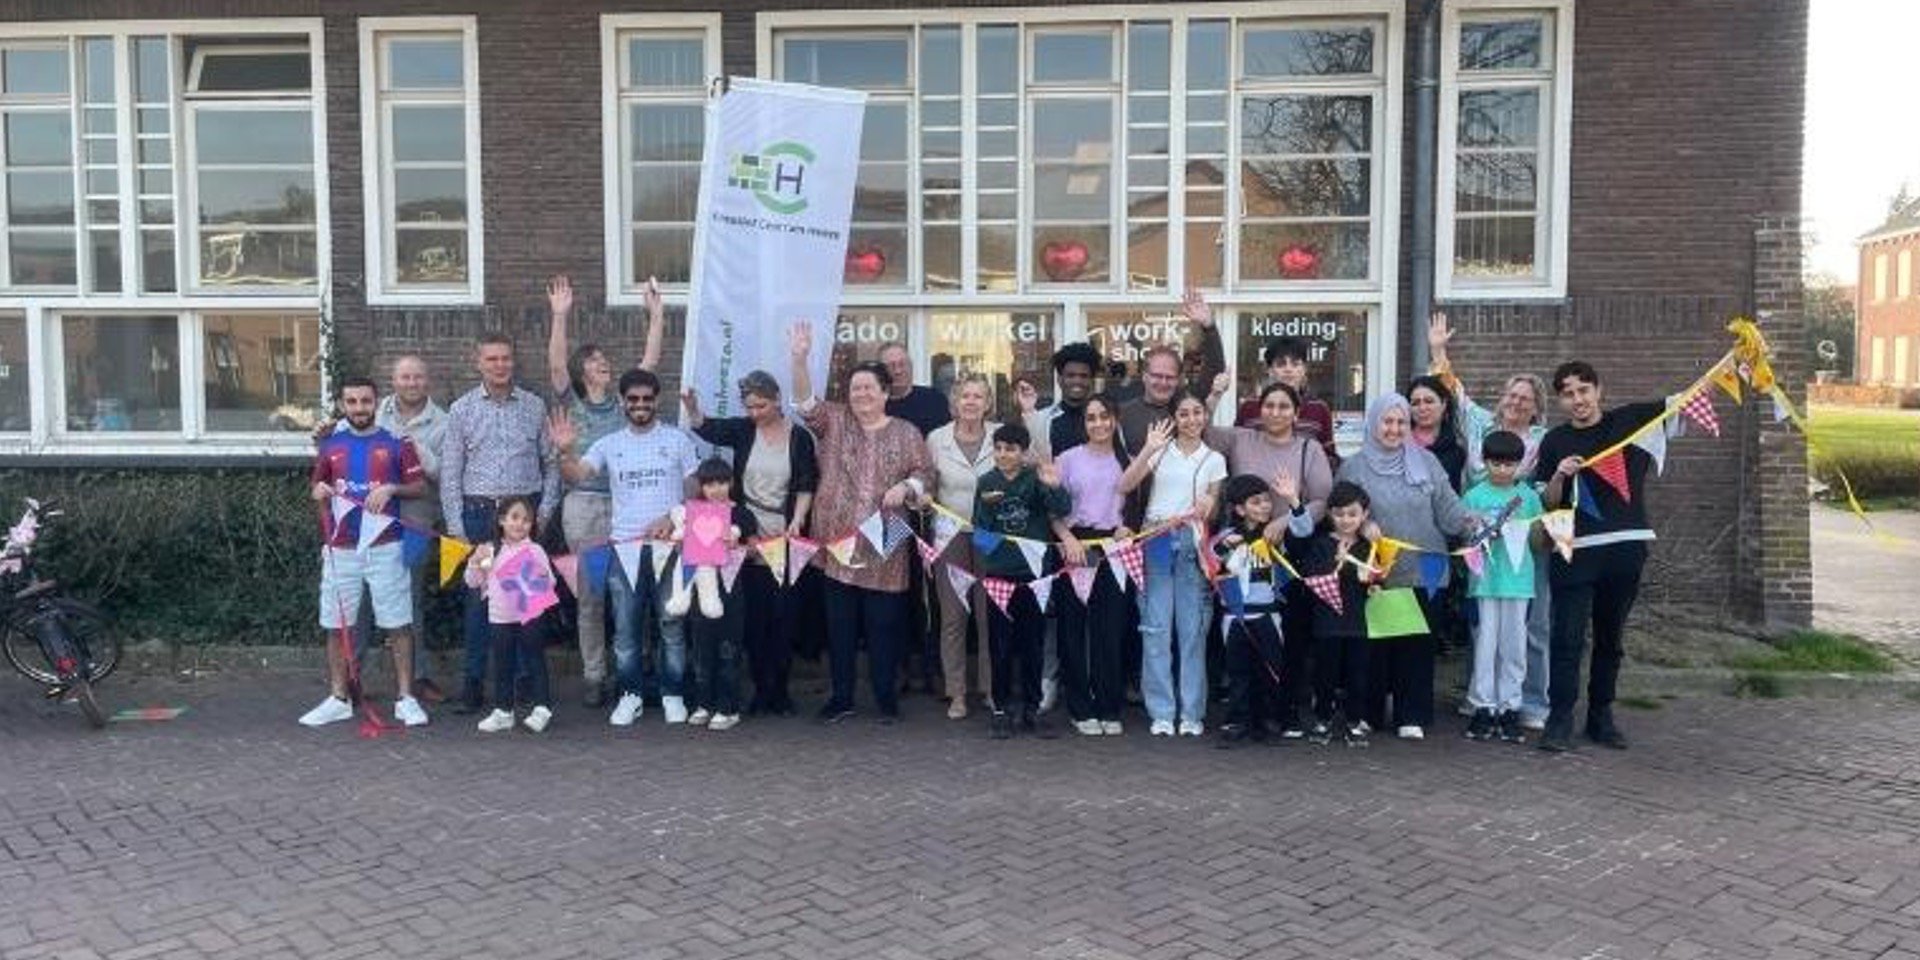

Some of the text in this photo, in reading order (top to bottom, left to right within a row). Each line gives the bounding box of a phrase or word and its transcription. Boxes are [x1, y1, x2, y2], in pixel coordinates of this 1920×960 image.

[836, 313, 900, 344] ado
[1109, 318, 1191, 342] work-
[1251, 317, 1346, 341] kleding-
[1257, 341, 1329, 362] rir
